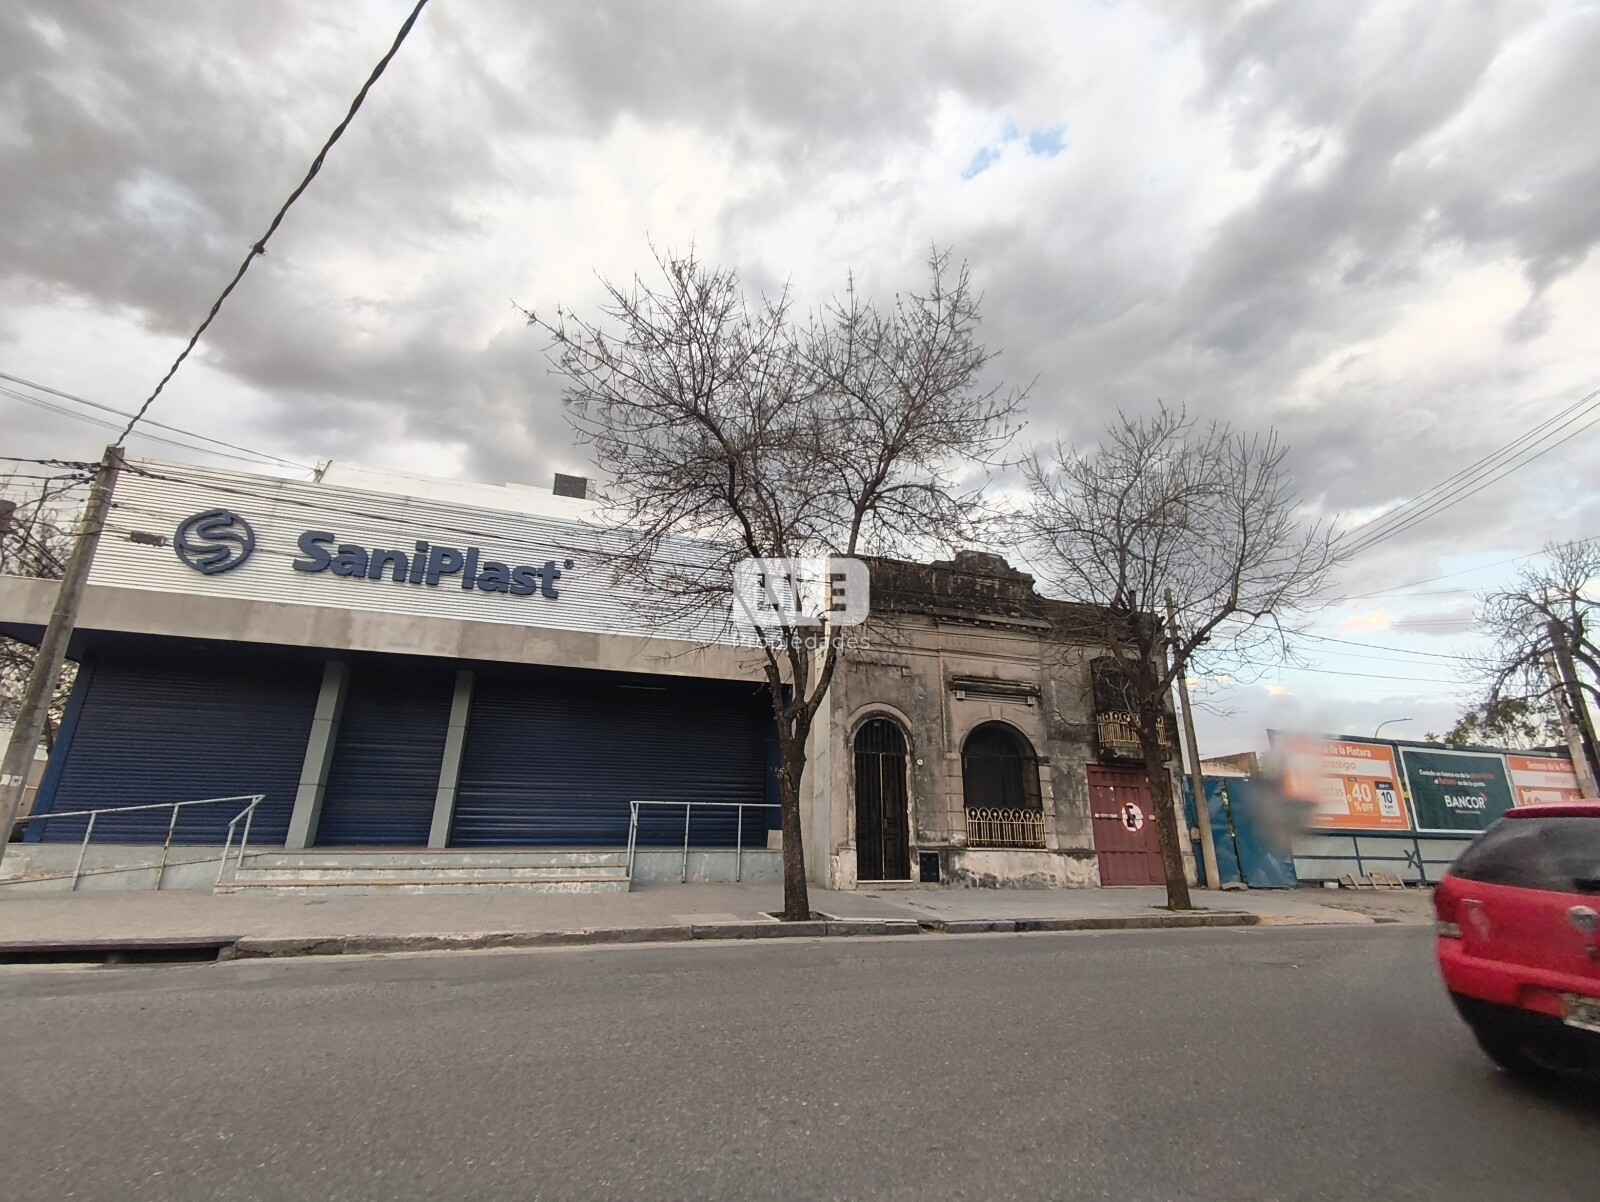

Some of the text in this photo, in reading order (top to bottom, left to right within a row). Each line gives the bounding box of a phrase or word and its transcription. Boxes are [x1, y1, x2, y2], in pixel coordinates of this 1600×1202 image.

[293, 530, 561, 599] SaniPlast
[1352, 783, 1372, 802] 40
[1381, 791, 1393, 804] 10
[1444, 795, 1486, 809] BANCOR
